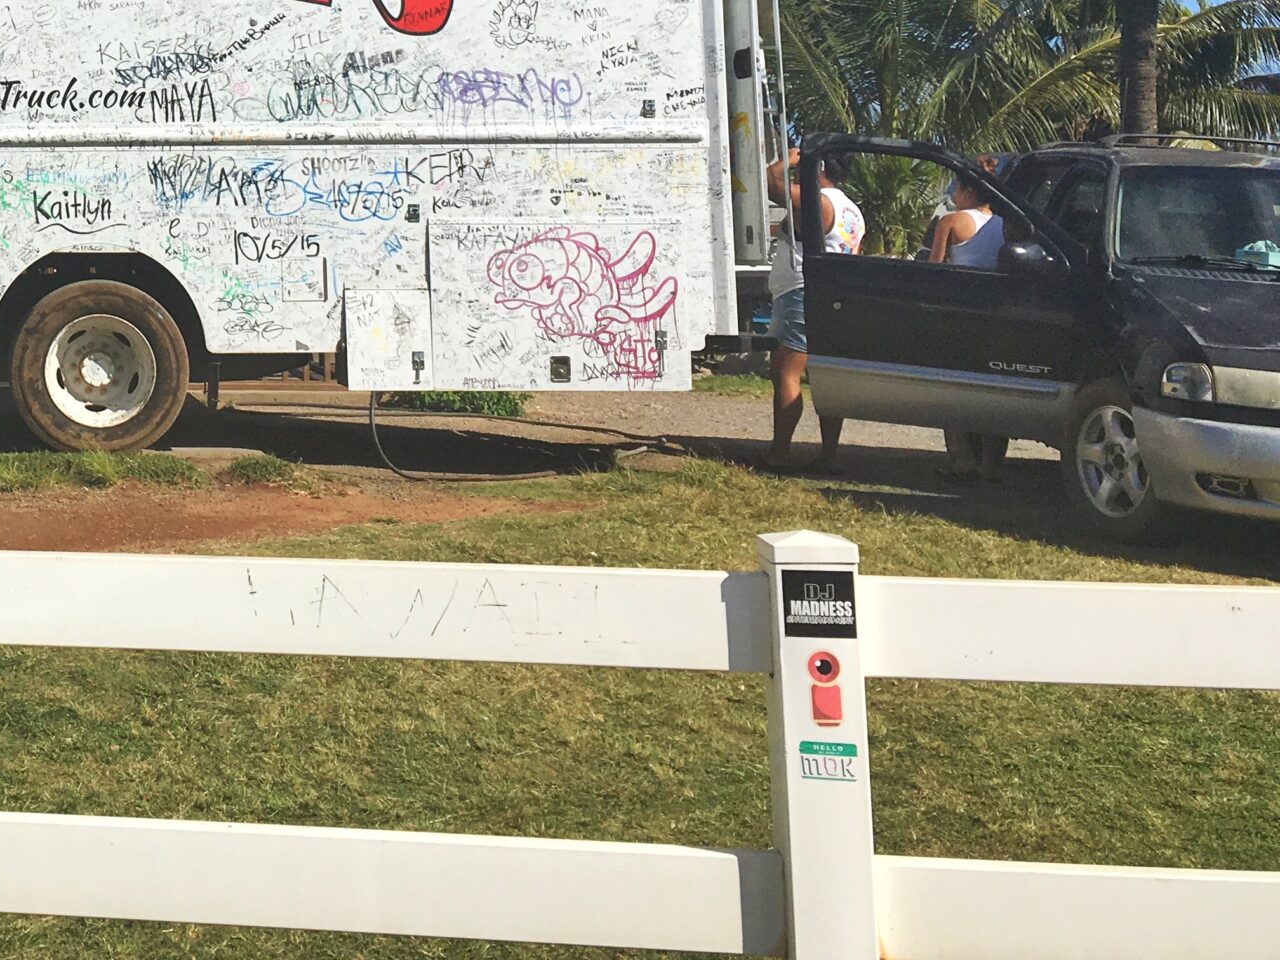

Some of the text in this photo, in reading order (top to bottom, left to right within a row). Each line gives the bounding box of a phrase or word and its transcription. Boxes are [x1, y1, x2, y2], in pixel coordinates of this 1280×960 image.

[97, 37, 188, 65] KAISER
[288, 30, 330, 53] JILL
[150, 78, 217, 123] MAYA
[33, 190, 112, 225] Kaitlyn
[989, 360, 1052, 374] QUEST
[804, 583, 835, 600] DJ
[790, 600, 853, 617] MADNESS
